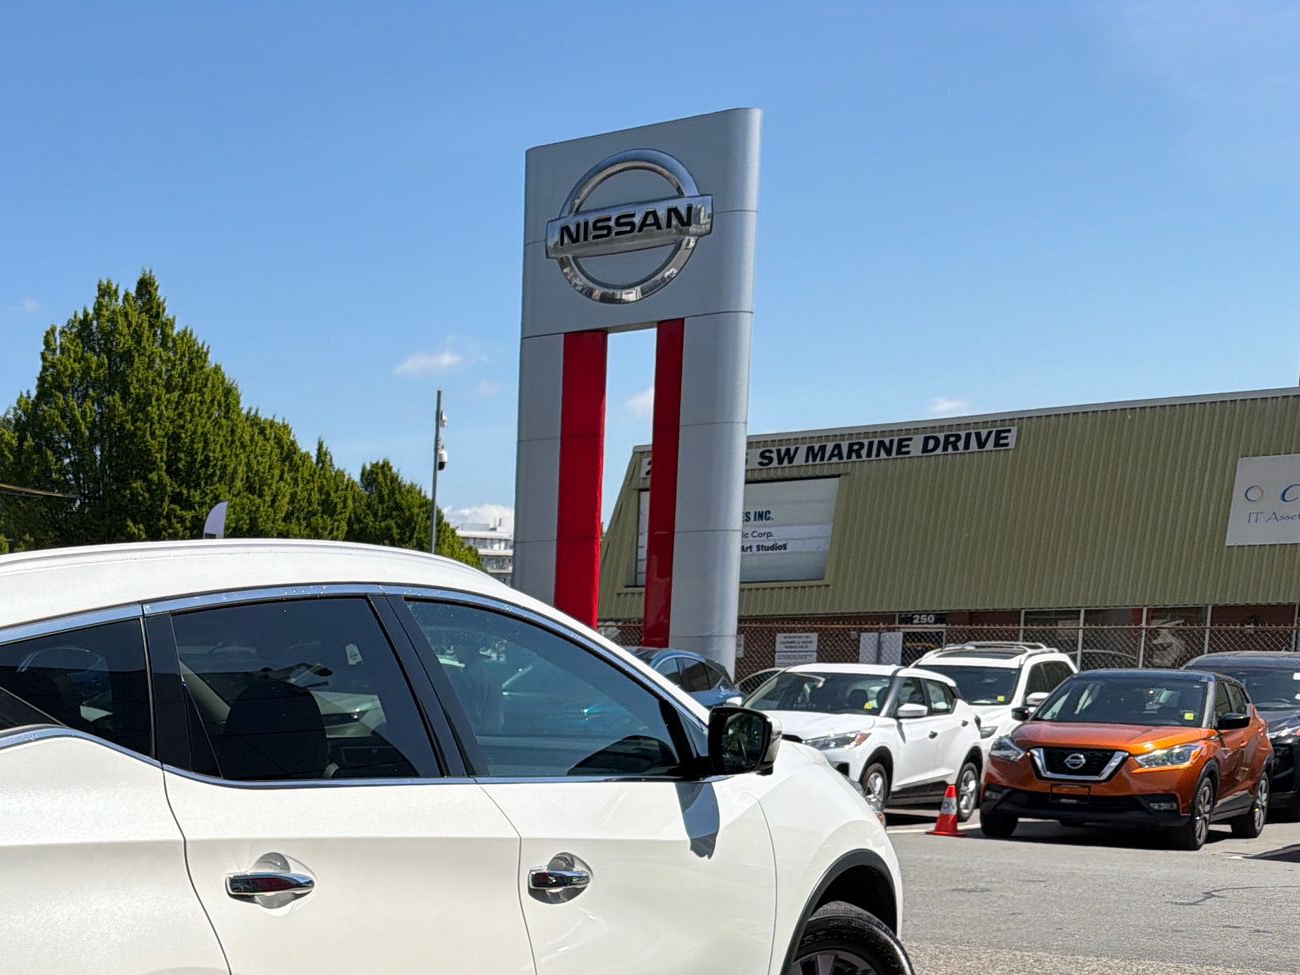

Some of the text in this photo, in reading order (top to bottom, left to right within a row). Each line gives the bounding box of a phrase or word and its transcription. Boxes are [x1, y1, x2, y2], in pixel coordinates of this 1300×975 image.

[559, 203, 693, 247] NISSAN
[757, 446, 800, 467] SW
[804, 437, 913, 463] MARINE
[920, 428, 1012, 455] DRIVE
[753, 510, 774, 522] INC.
[751, 530, 774, 539] Corp.
[756, 543, 788, 552] Studios
[912, 614, 935, 624] 250
